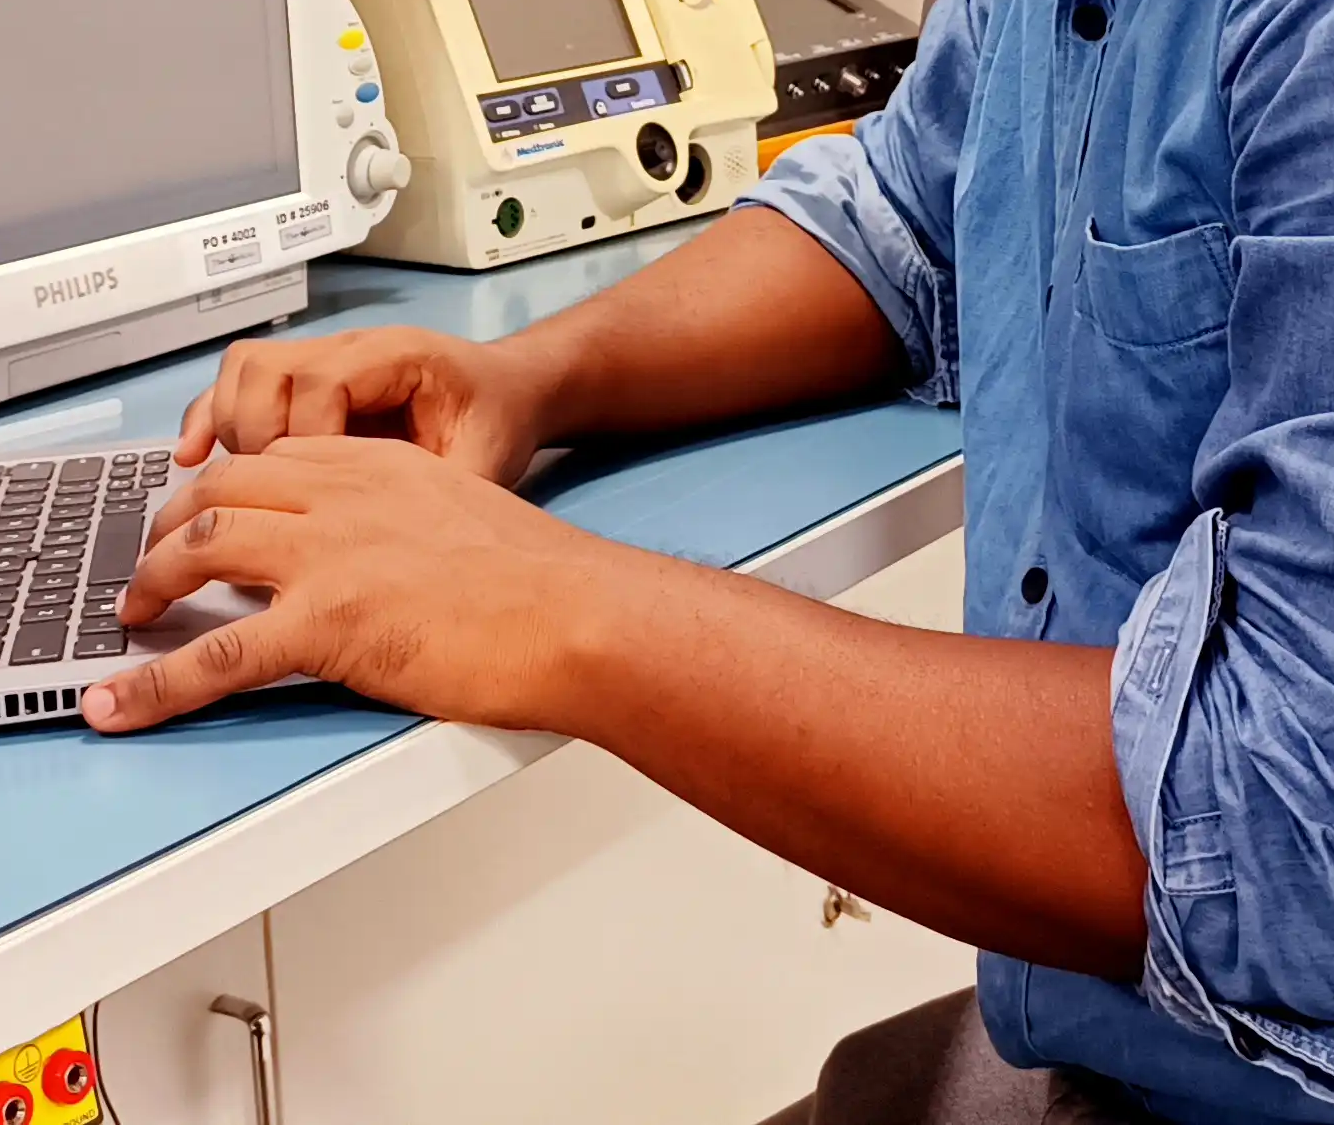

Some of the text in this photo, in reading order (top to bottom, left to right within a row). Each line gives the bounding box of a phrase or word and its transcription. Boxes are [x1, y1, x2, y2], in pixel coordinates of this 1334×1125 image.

[516, 139, 565, 157] Medtronic
[275, 214, 287, 225] ID
[299, 199, 330, 219] 25906
[202, 236, 219, 250] PO
[231, 226, 257, 242] 4002
[33, 267, 119, 309] PHILIPS
